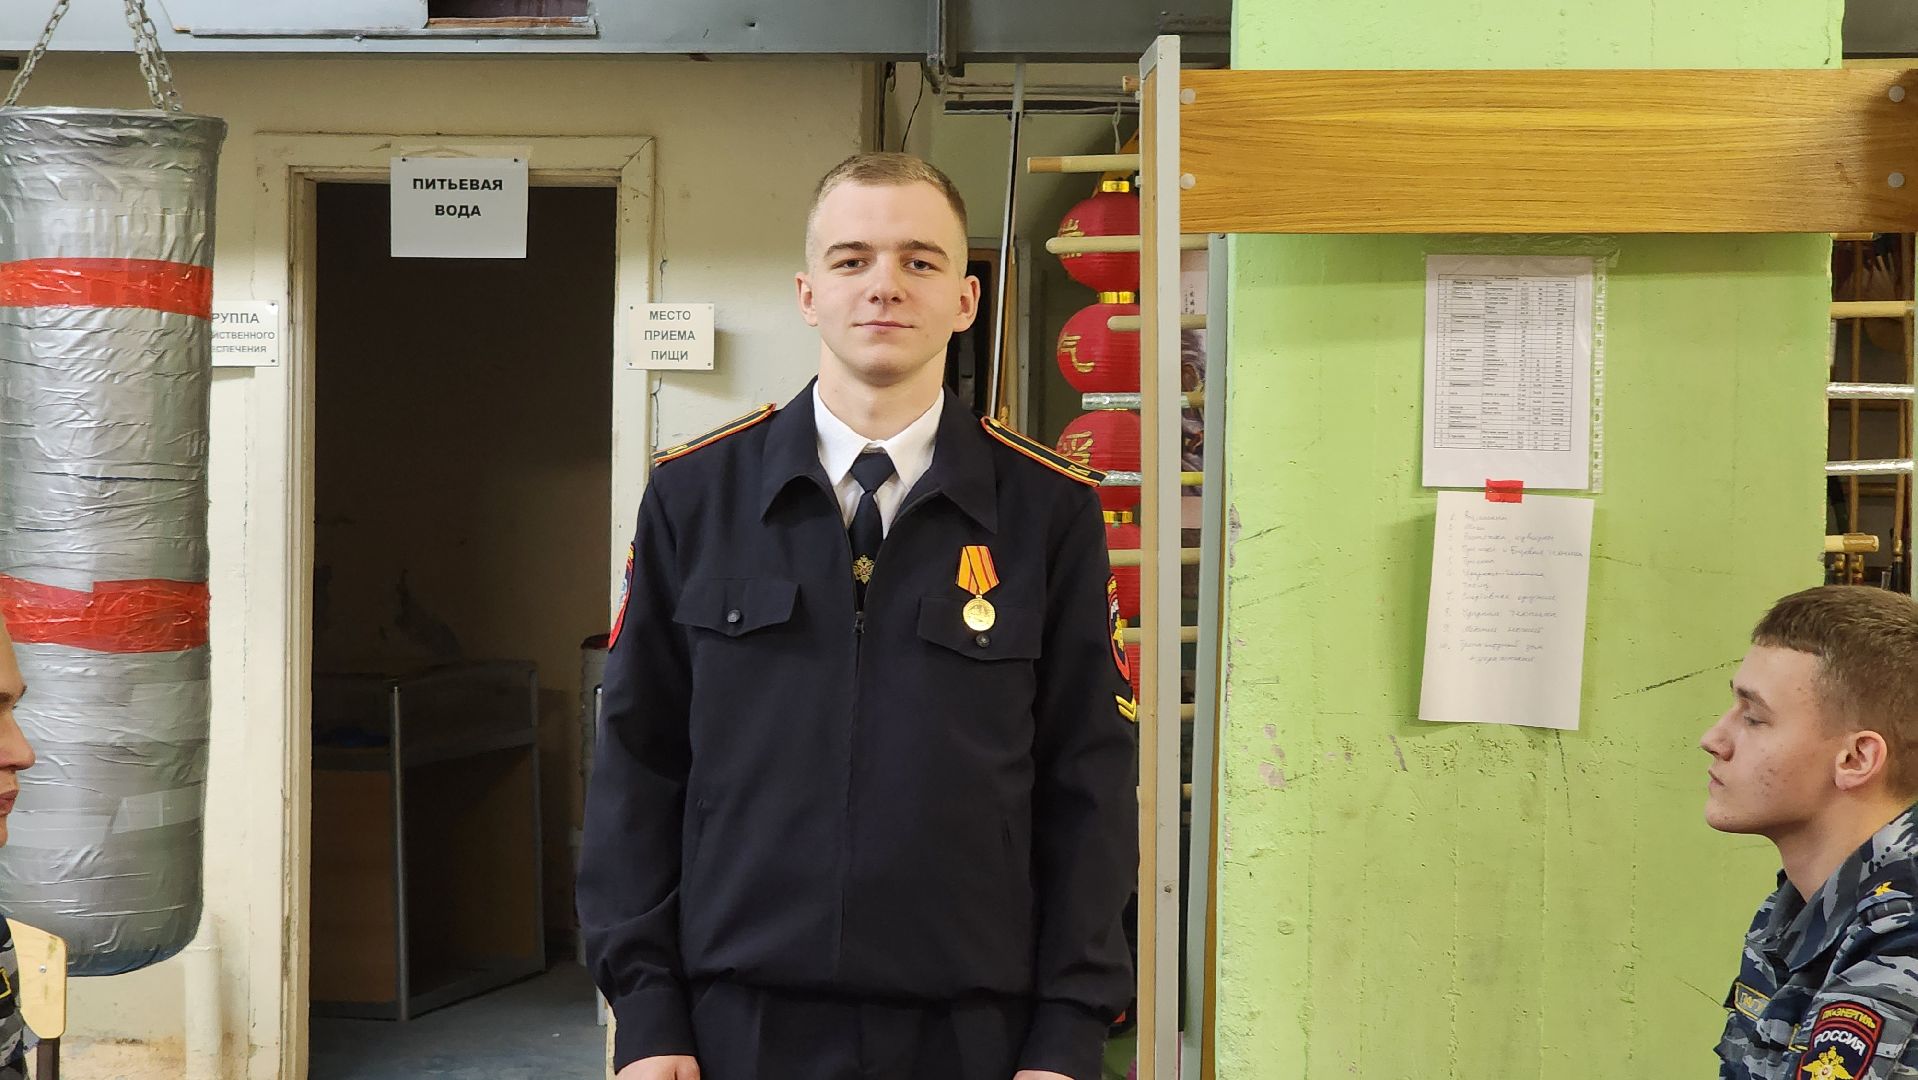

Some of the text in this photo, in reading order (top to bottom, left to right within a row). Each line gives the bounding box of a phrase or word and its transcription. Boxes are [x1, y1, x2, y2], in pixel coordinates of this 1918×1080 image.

[412, 178, 503, 191] ПИТЬЕВАЯ
[434, 204, 482, 218] ВОДА
[649, 310, 691, 321] МЕСТО
[644, 330, 696, 341] ПРИЕМА
[651, 350, 689, 363] ПИЩИ
[1814, 1029, 1867, 1056] РОССИЯ
